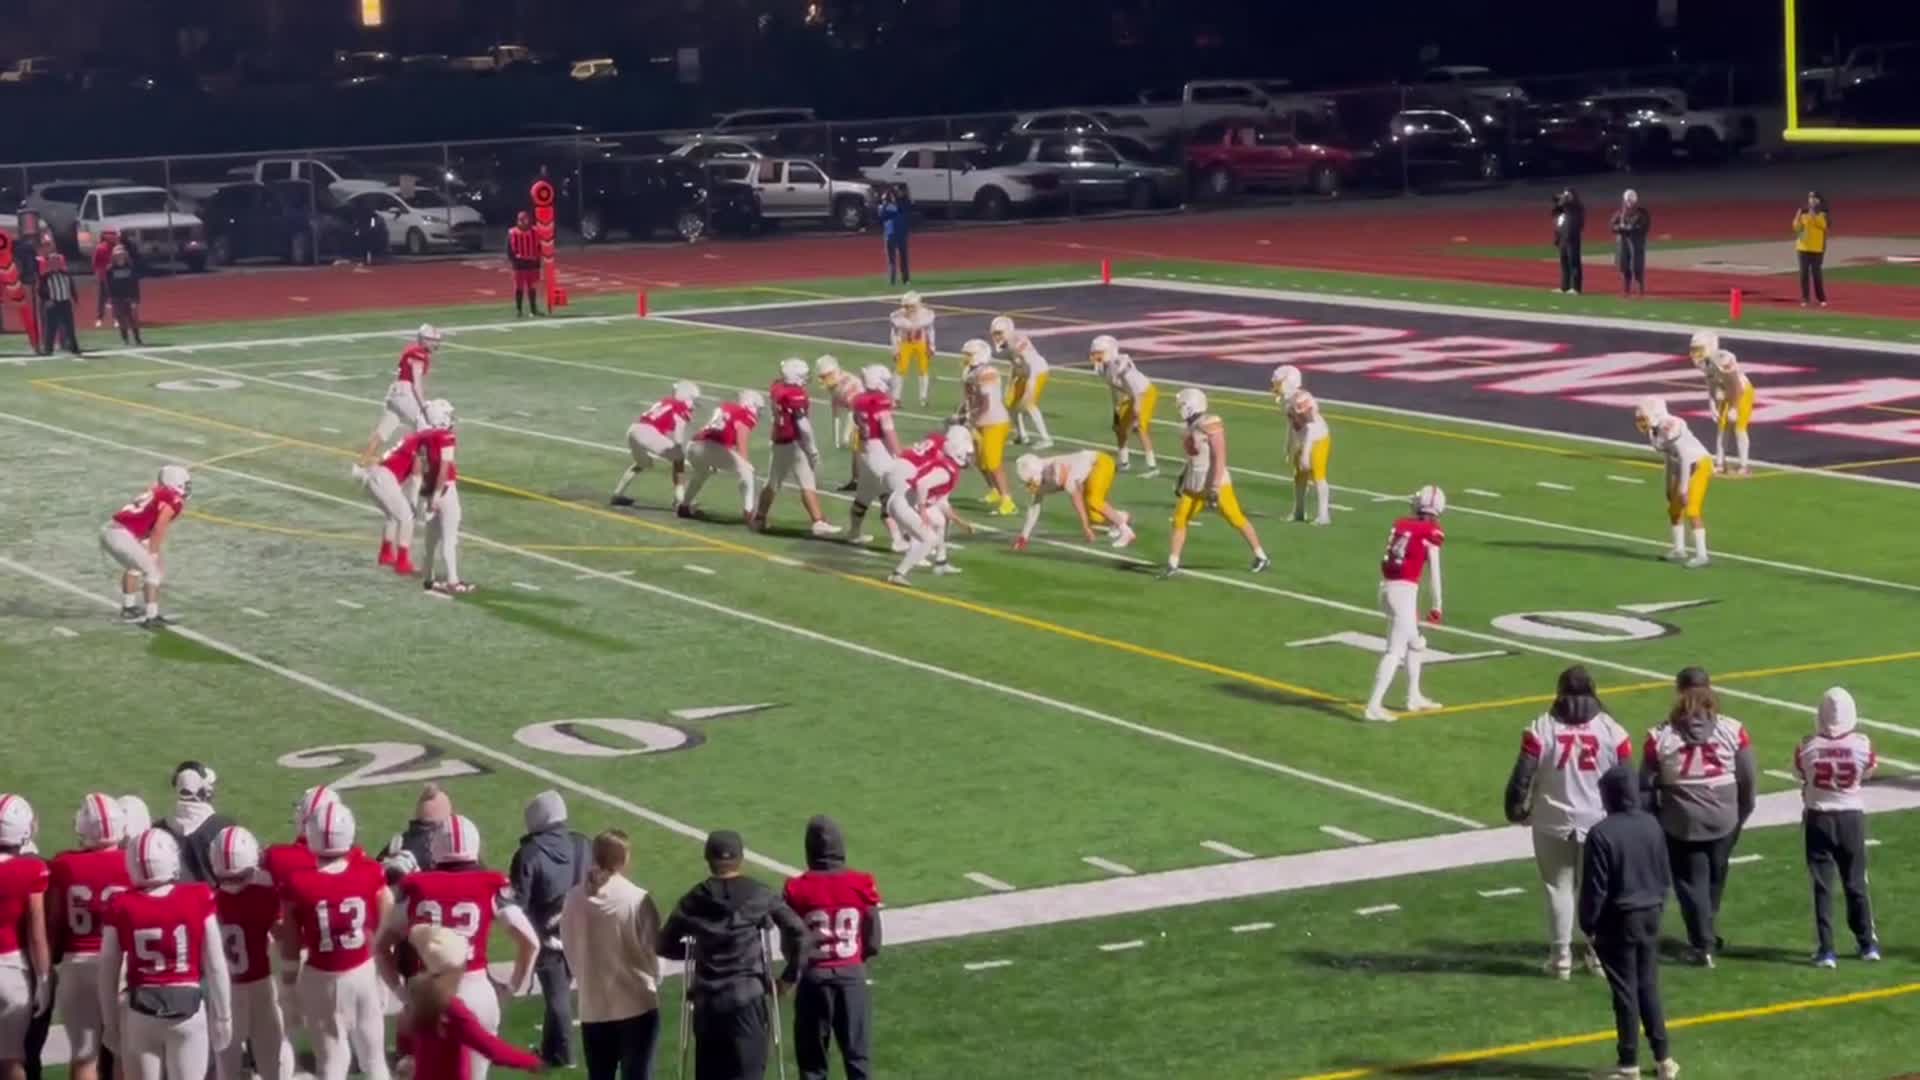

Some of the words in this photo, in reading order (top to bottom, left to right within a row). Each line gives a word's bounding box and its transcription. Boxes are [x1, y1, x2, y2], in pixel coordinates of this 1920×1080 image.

[1016, 309, 1920, 445] TORNA
[277, 717, 698, 790] 20
[1556, 733, 1599, 770] 72
[1679, 743, 1724, 777] 75
[66, 884, 129, 935] 6
[316, 896, 367, 952] 13
[133, 924, 190, 975] 51
